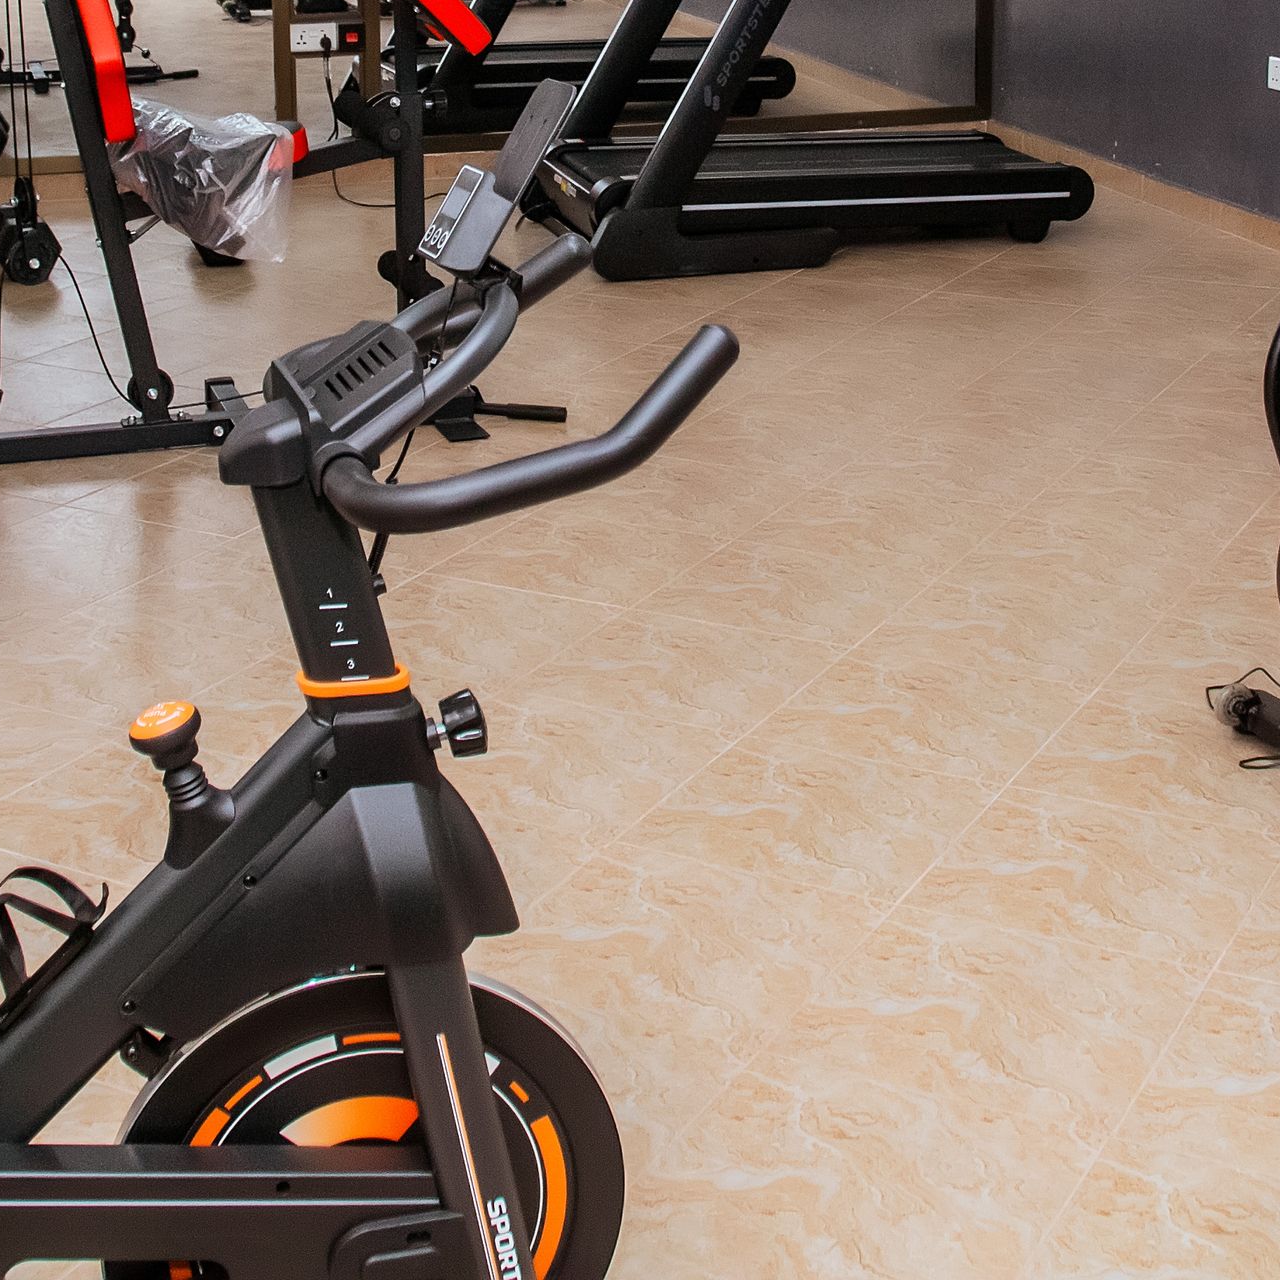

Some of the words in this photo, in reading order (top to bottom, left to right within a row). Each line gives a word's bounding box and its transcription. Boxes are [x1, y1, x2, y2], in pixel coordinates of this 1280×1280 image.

[326, 587, 333, 599] 1
[335, 621, 344, 633] 2
[346, 659, 355, 670] 3
